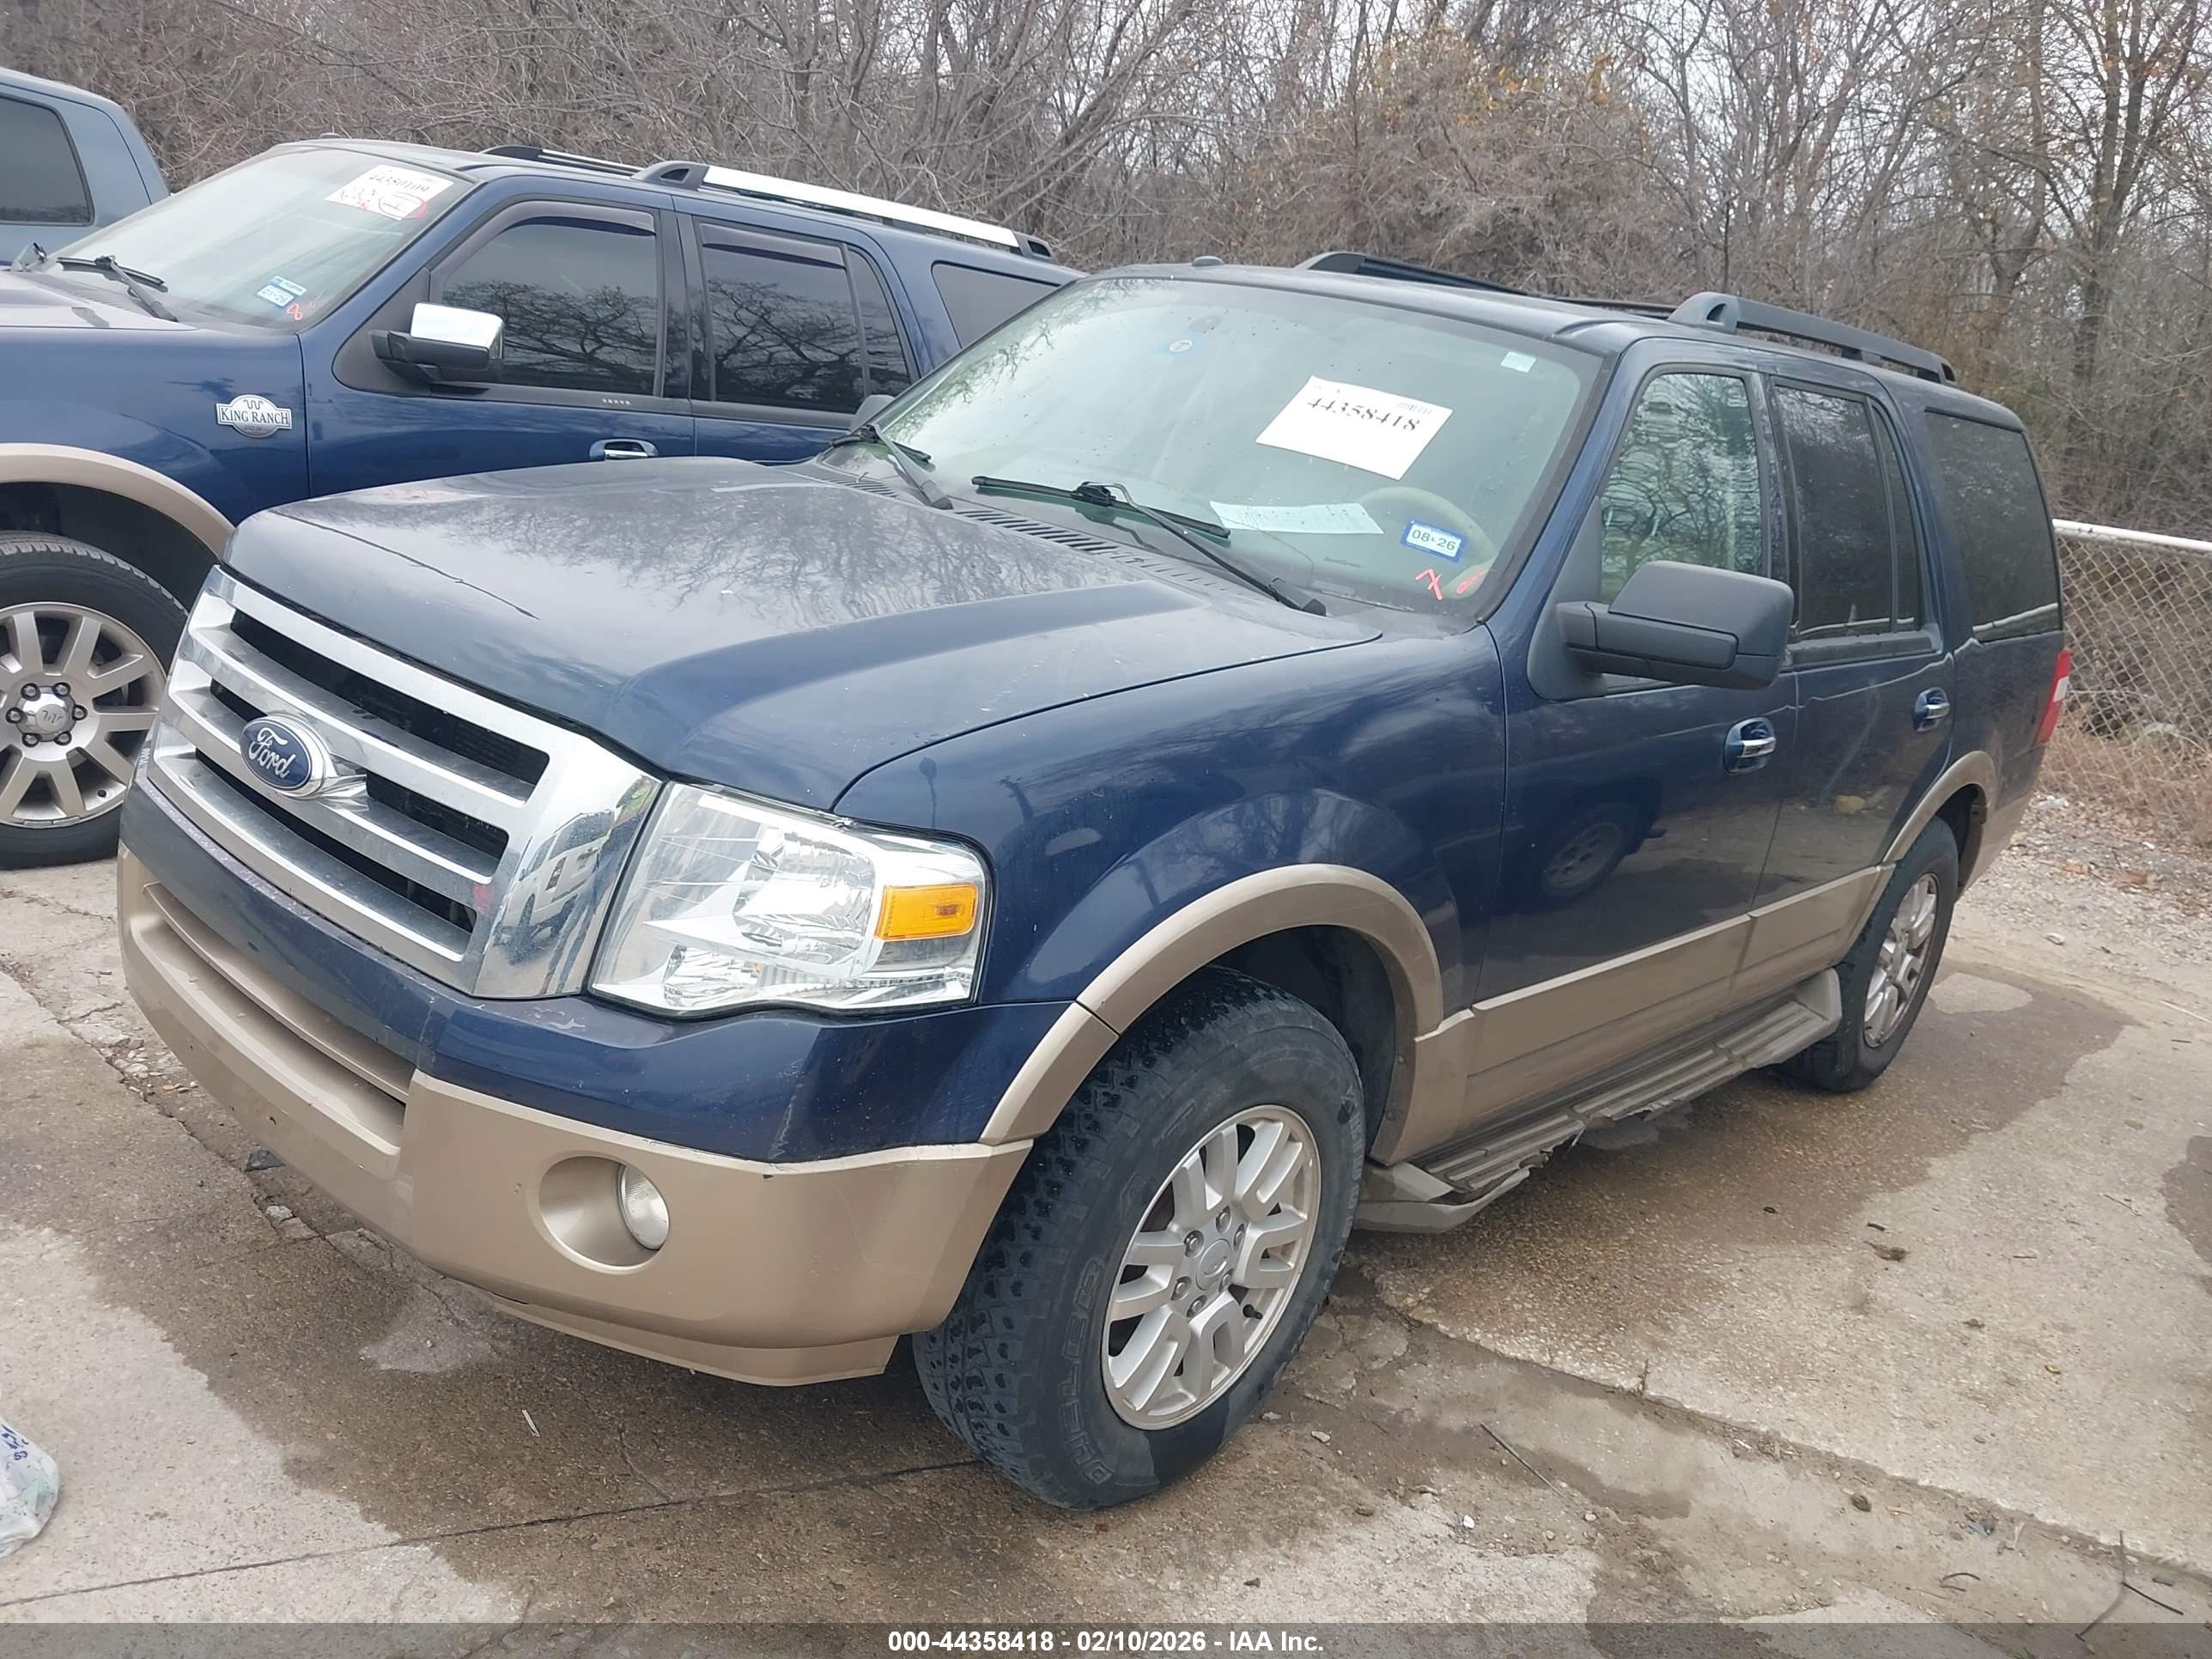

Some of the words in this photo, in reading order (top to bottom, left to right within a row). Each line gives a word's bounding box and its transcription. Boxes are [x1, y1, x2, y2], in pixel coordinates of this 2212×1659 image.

[221, 407, 249, 422] KING
[252, 410, 289, 424] RANCH
[1307, 398, 1420, 431] 44358418
[248, 726, 296, 779] Ford
